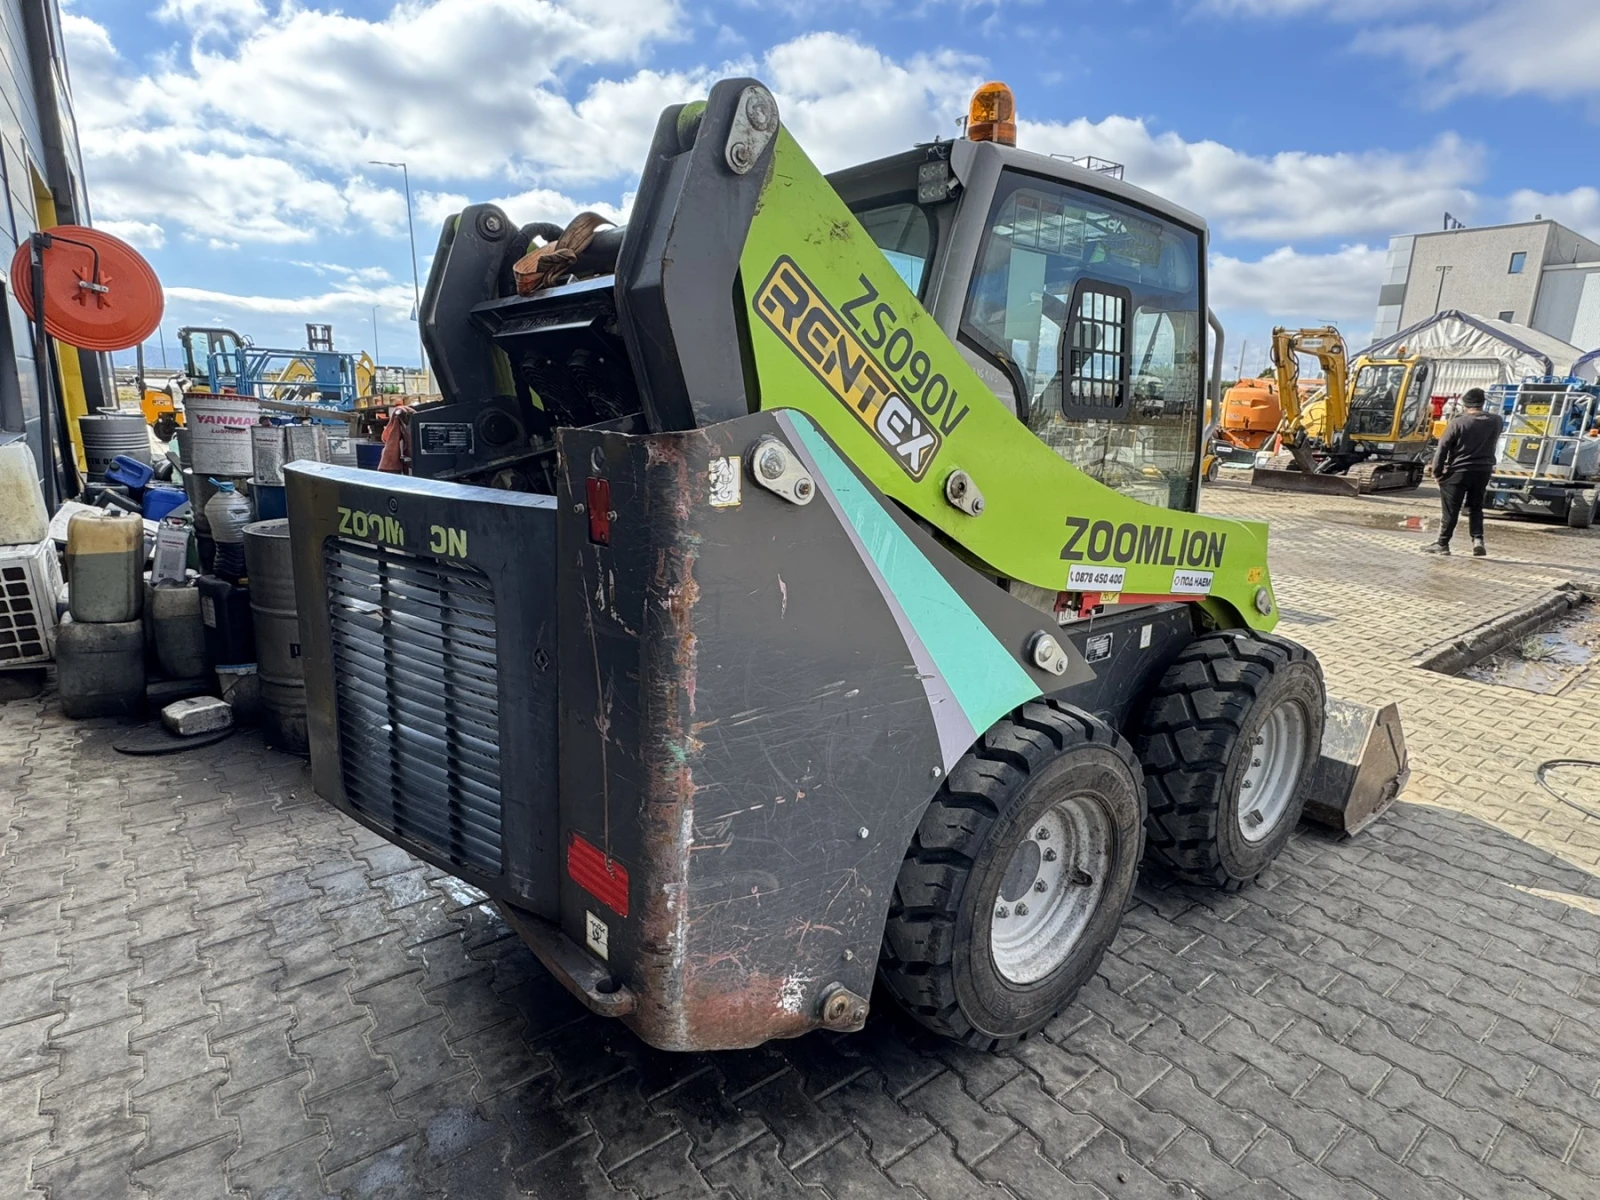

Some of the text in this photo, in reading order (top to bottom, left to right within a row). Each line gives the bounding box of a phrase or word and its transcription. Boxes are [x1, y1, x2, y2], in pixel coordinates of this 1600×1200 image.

[762, 268, 935, 472] RENTEX
[840, 272, 970, 438] ZS090V
[1059, 516, 1227, 568] ZOOMLION
[1075, 571, 1123, 585] 0878 450 400
[1180, 576, 1212, 588] ПОД НАЕМ
